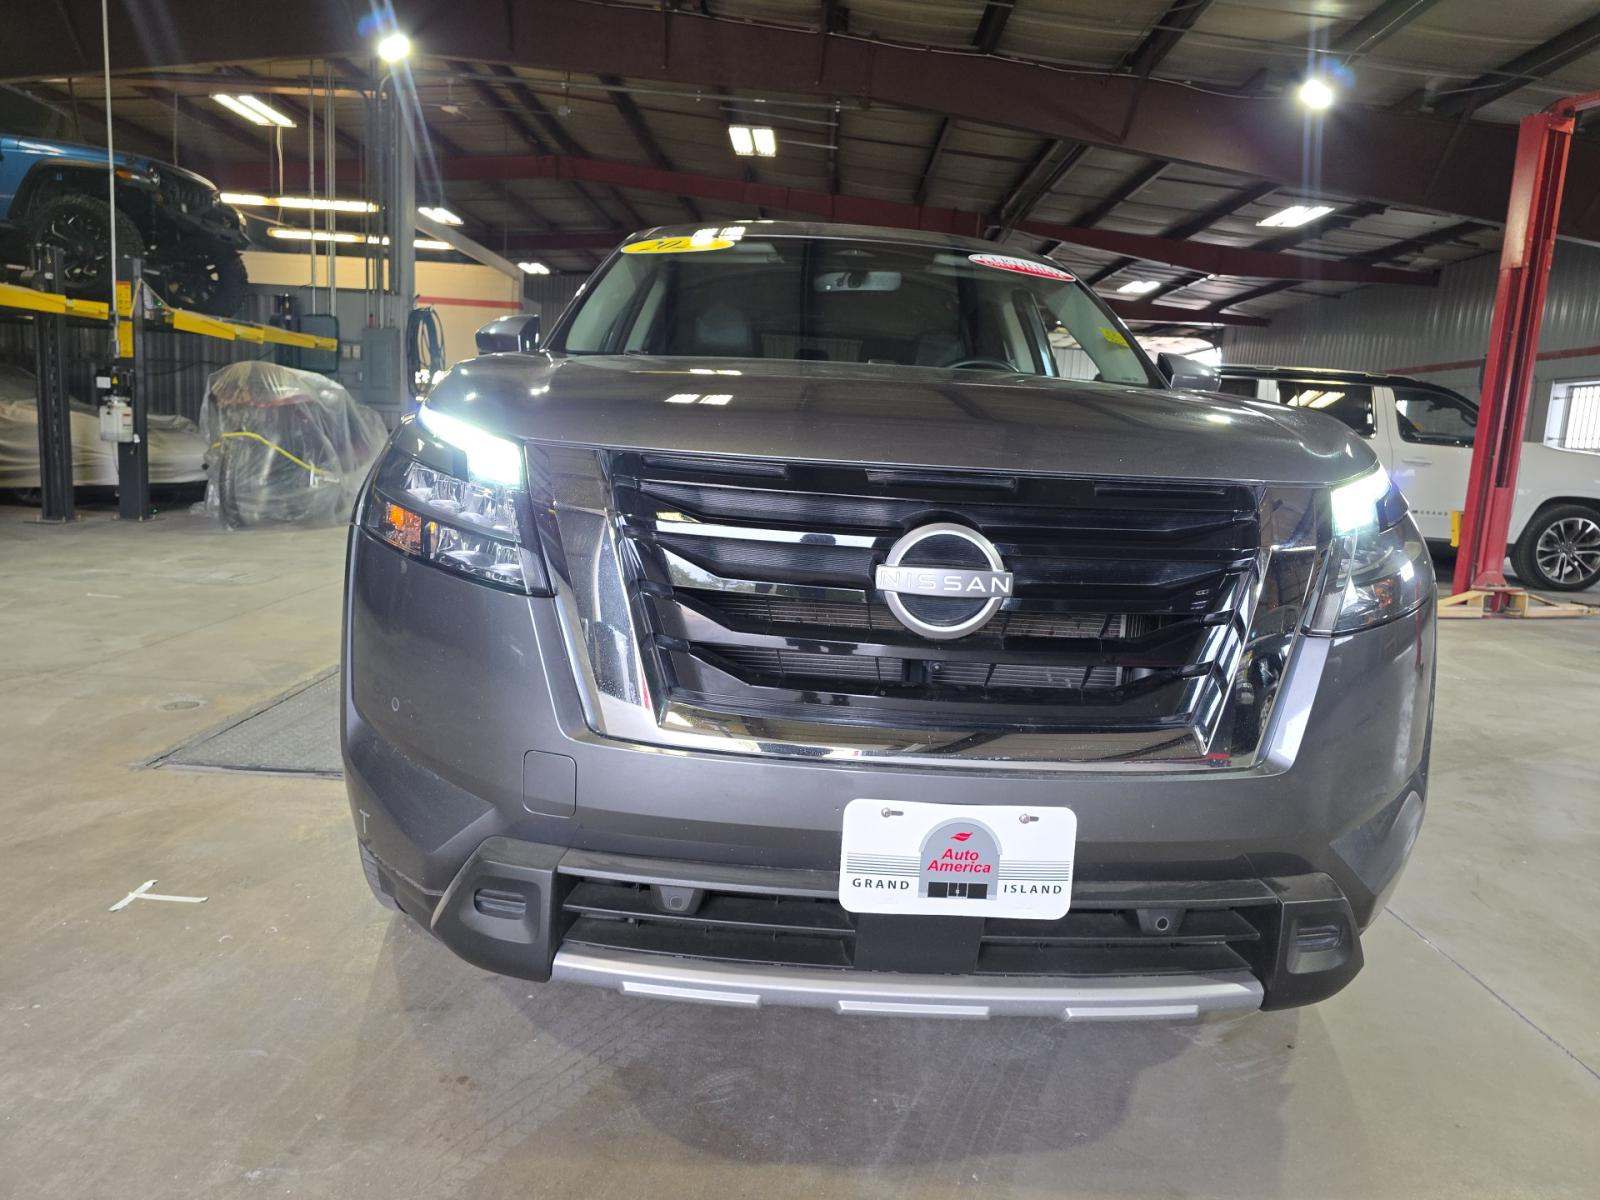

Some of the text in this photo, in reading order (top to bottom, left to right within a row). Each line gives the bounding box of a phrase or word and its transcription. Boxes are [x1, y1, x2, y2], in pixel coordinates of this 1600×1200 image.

[880, 570, 1010, 593] NISSAN
[941, 848, 979, 861] Auto
[927, 860, 991, 873] America
[852, 878, 1063, 895] GRAND ISLAND
